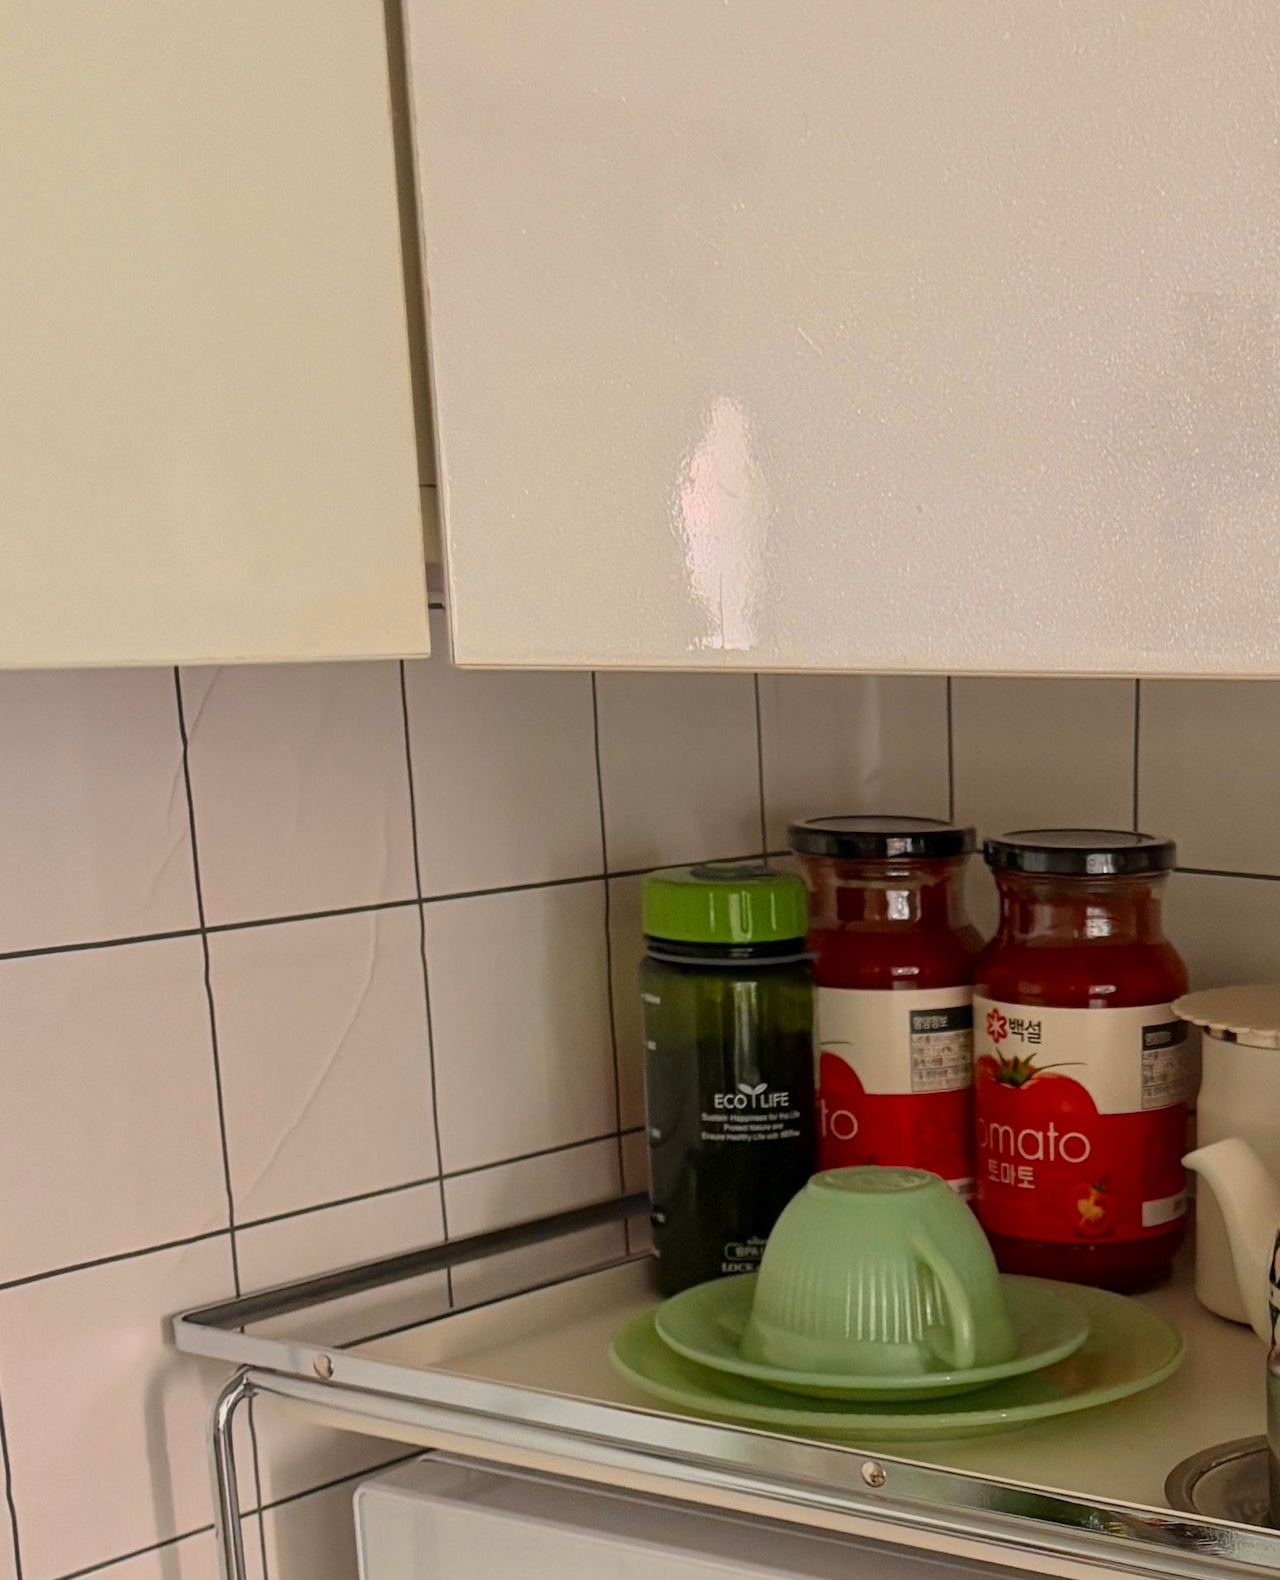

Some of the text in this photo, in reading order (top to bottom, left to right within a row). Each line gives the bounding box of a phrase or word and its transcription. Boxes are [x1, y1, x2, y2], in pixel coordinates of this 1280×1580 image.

[1008, 1018, 1042, 1044] 백설
[714, 1092, 790, 1109] ECO LIFE
[987, 1158, 1036, 1189] 토마토
